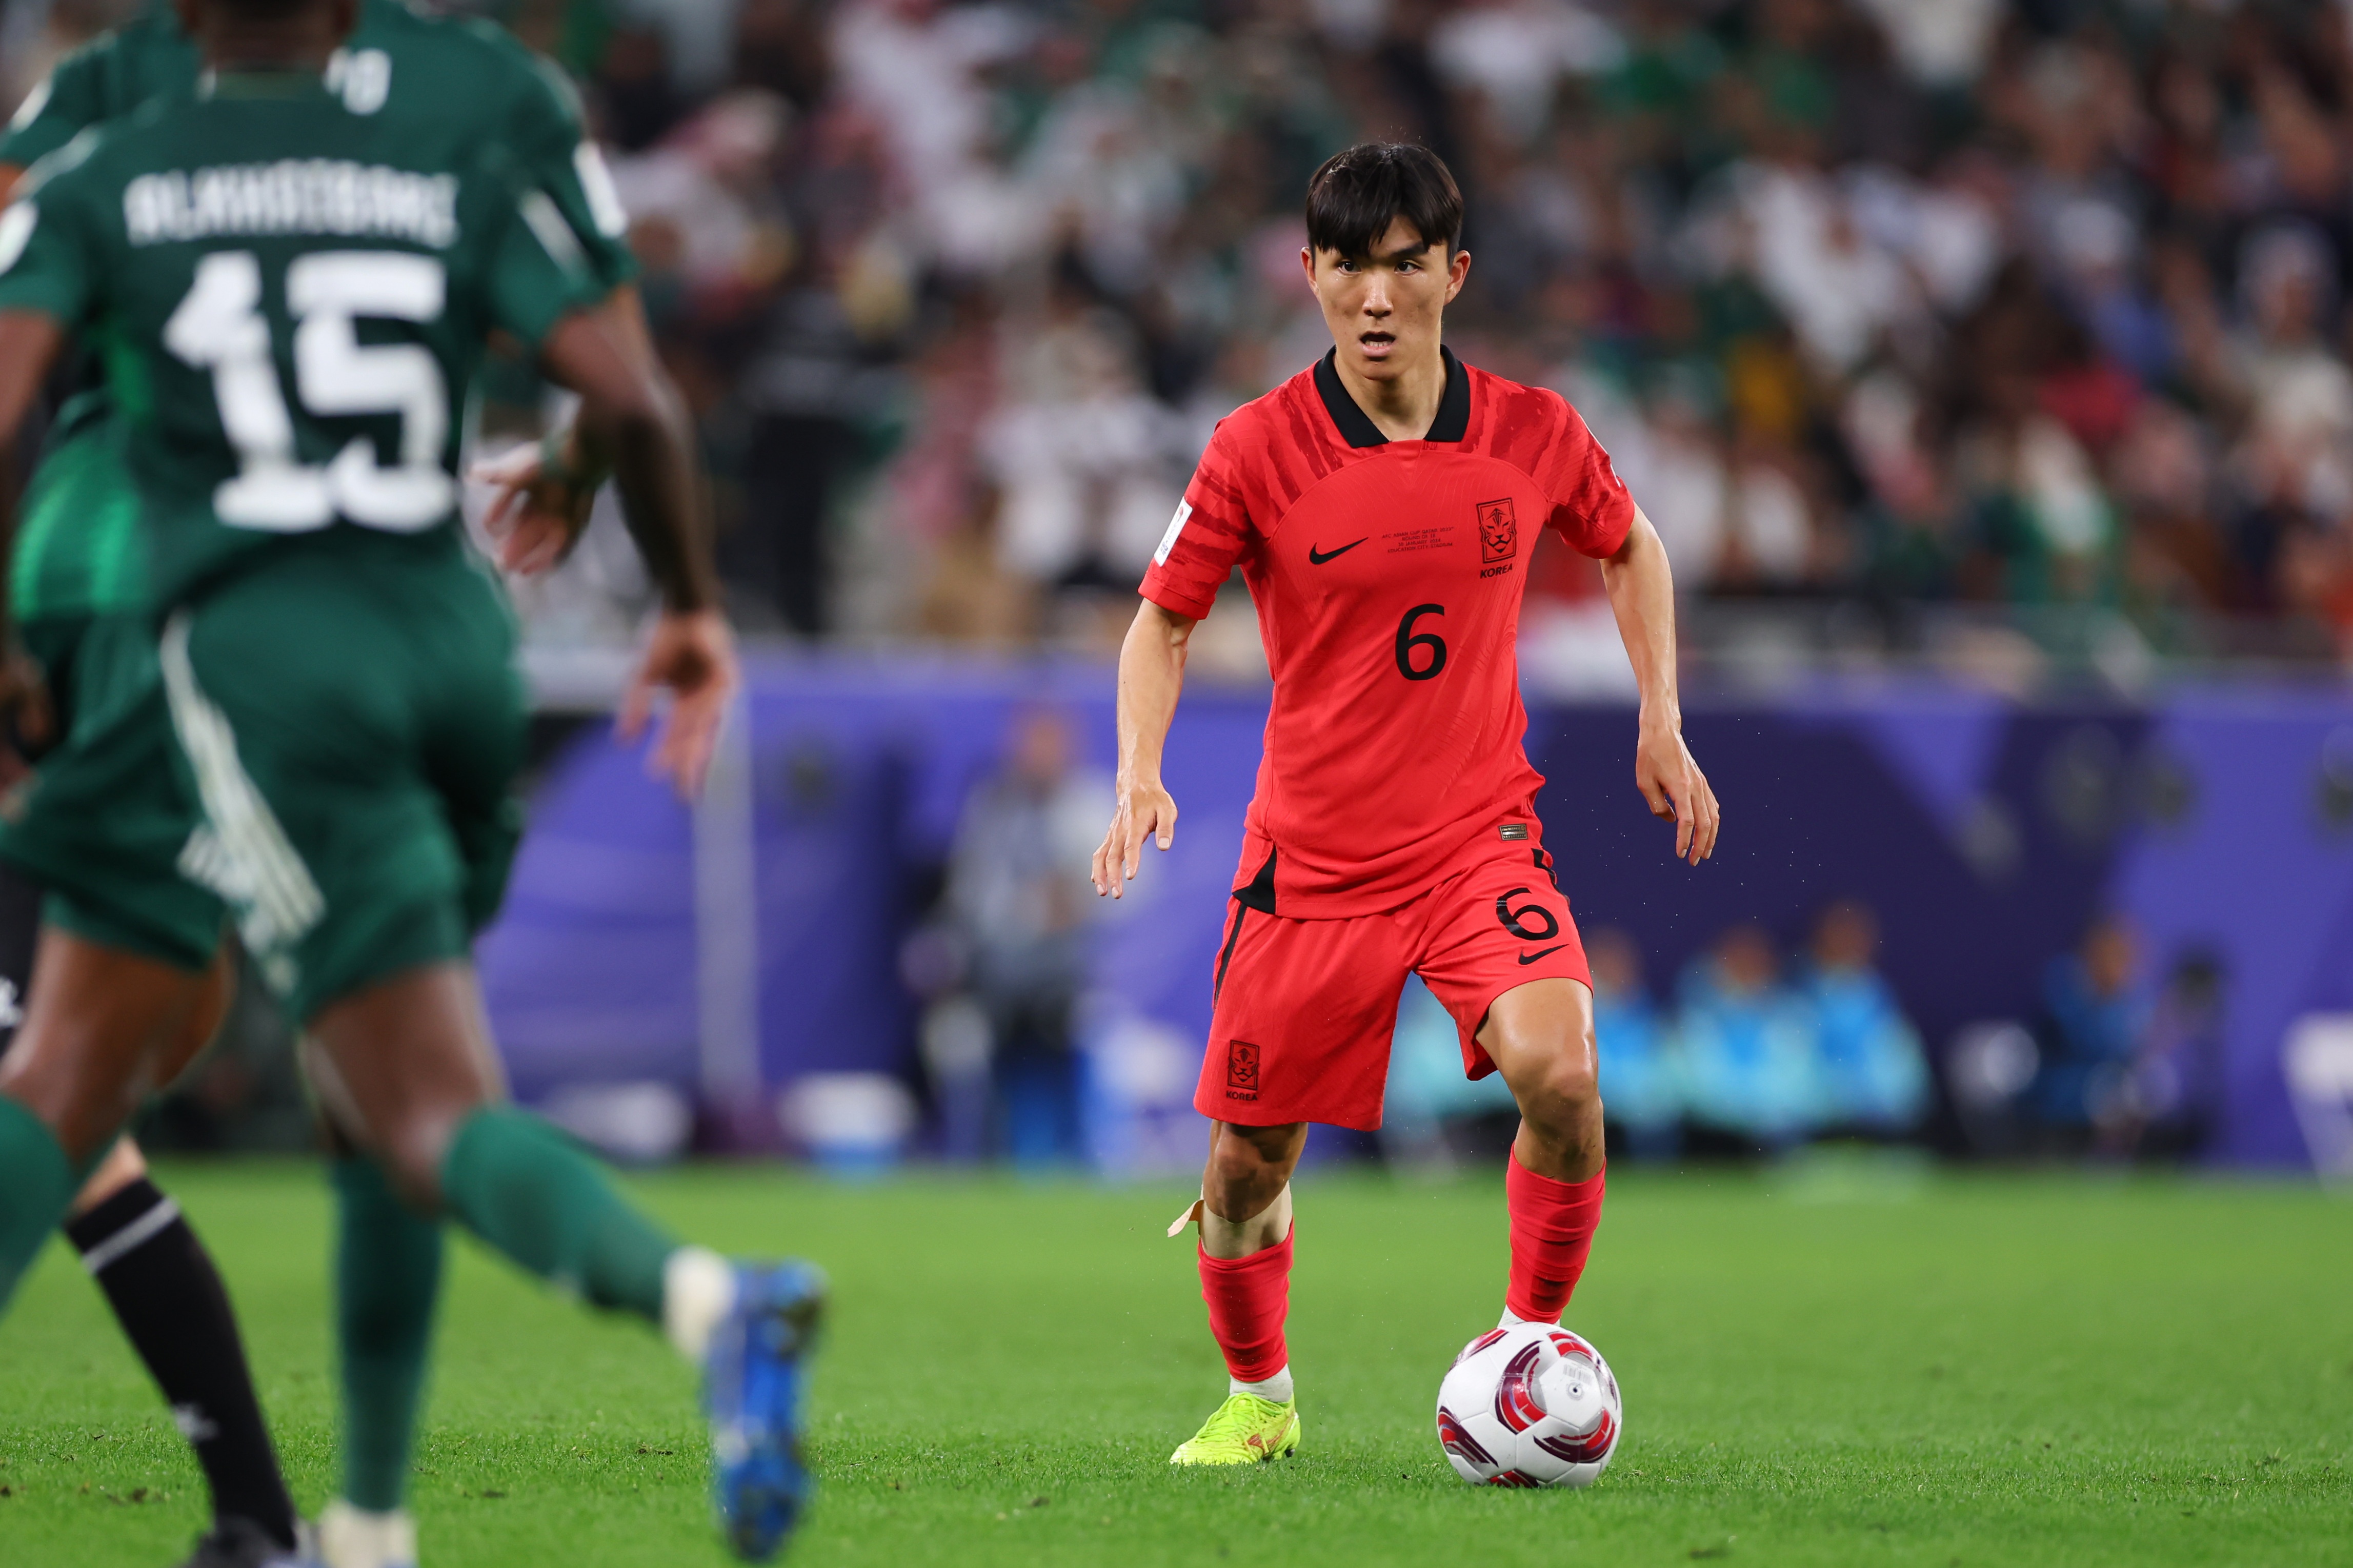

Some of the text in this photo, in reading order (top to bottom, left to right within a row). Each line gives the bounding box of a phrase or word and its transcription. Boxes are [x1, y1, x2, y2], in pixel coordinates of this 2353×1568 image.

[166, 250, 454, 531] 15
[1480, 563, 1513, 579] KOREA
[1395, 603, 1447, 681] 6
[1496, 887, 1559, 941] 6
[1226, 1090, 1258, 1101] KOREA
